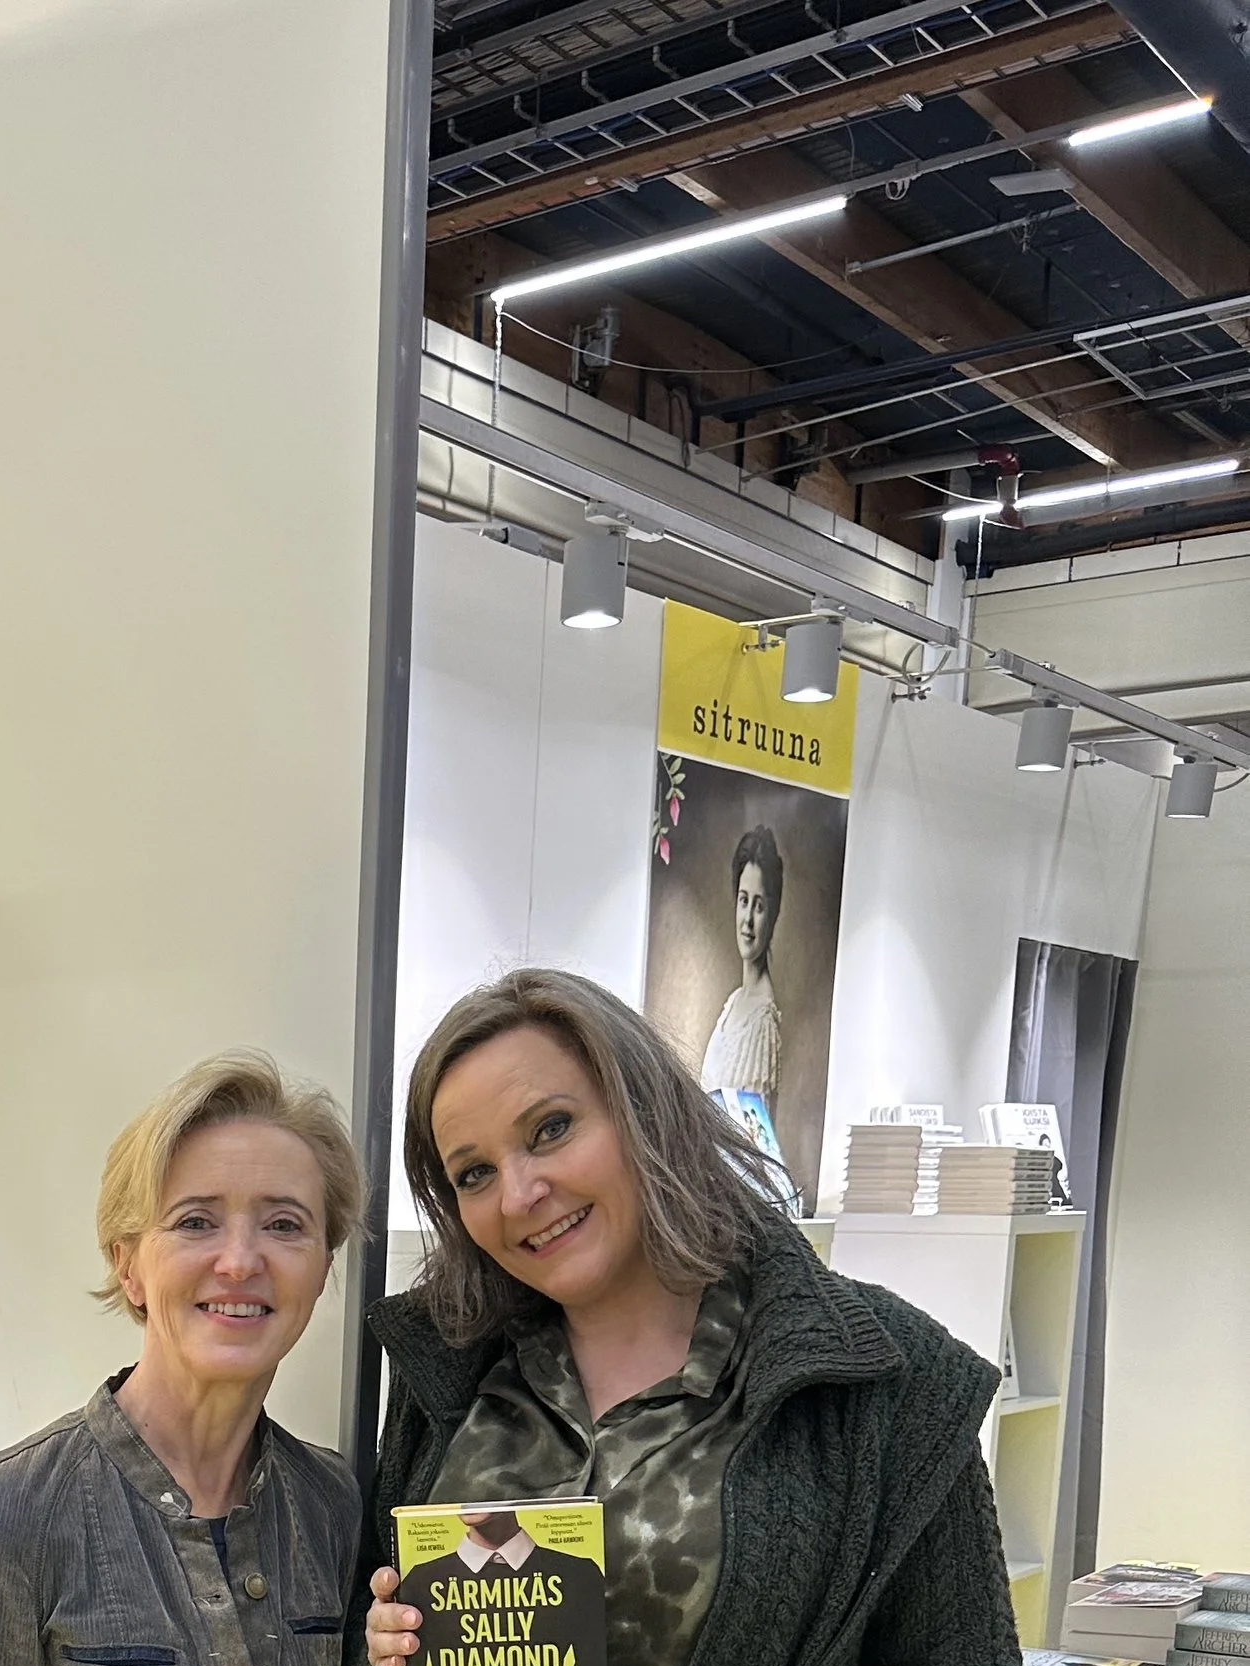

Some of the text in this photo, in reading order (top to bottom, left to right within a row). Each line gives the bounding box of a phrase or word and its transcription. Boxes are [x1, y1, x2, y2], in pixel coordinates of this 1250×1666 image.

[692, 699, 822, 766] sitruuna
[430, 1572, 563, 1611] SÄRMIKÄS
[460, 1611, 534, 1644] SALLY
[1194, 1639, 1247, 1654] ARCHER
